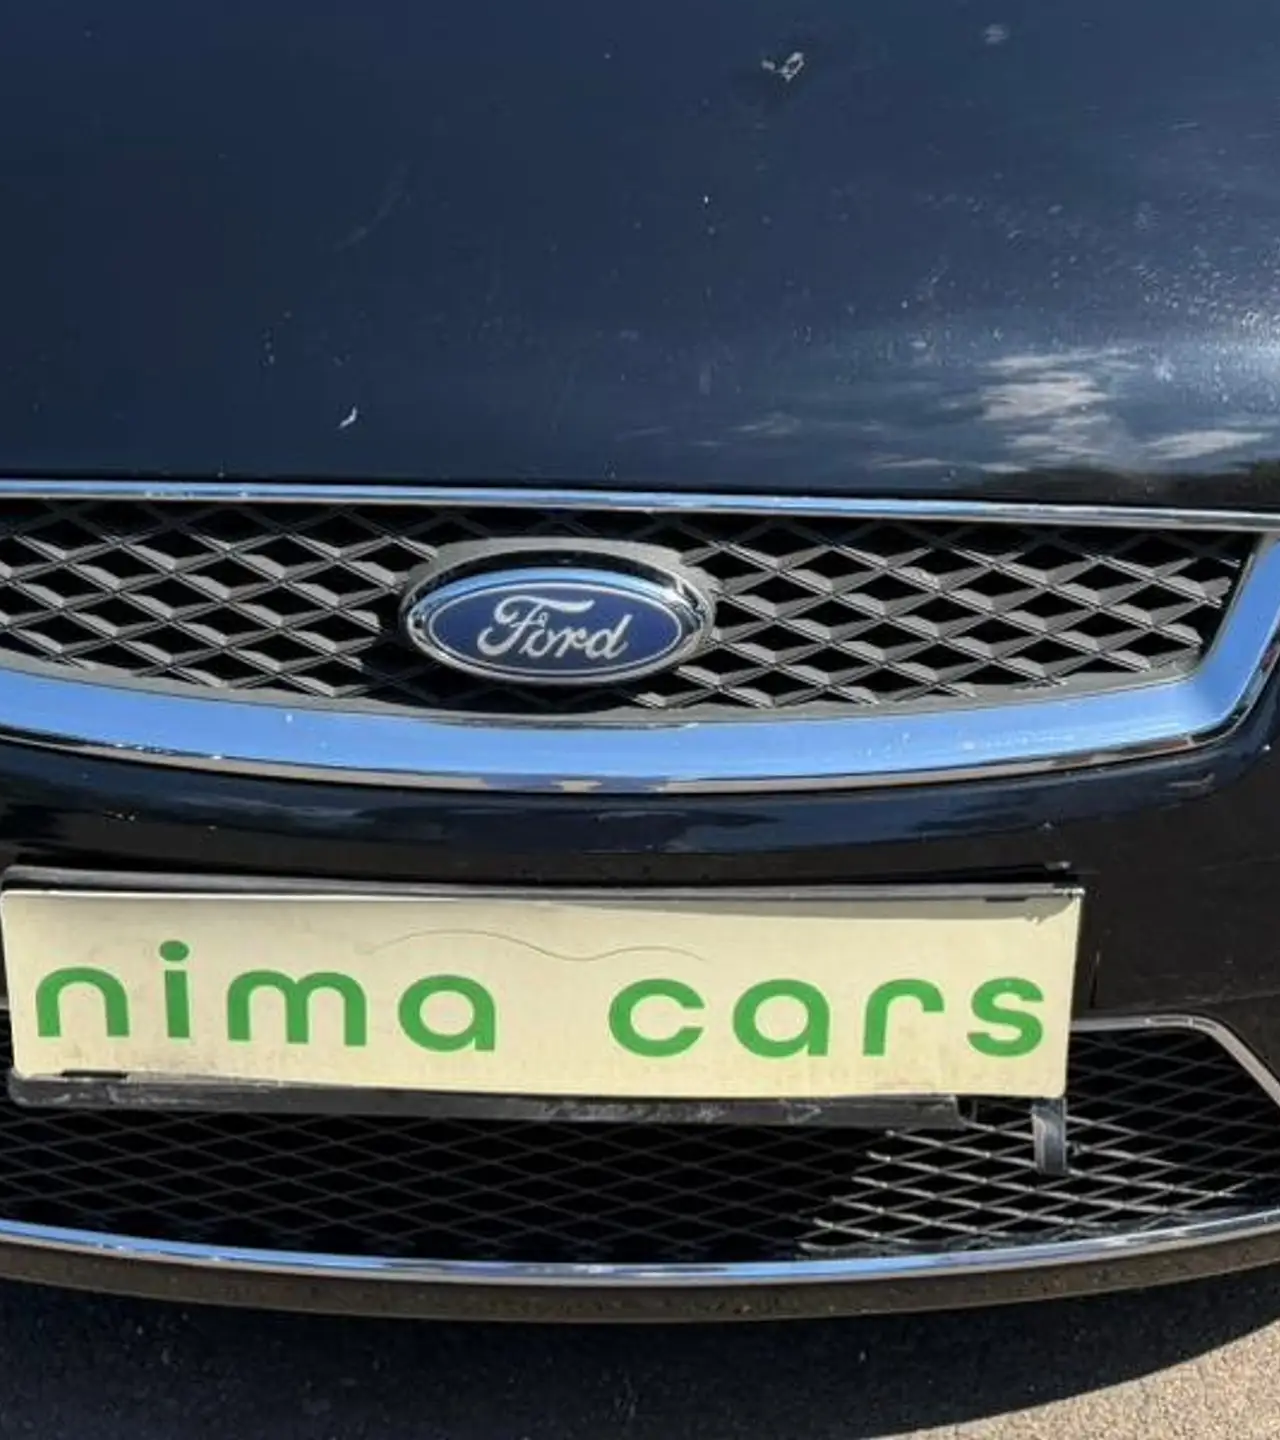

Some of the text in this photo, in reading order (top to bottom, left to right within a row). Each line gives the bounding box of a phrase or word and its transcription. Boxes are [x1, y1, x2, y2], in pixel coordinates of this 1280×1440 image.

[477, 594, 633, 660] Ford
[35, 939, 1045, 1059] nima cars
